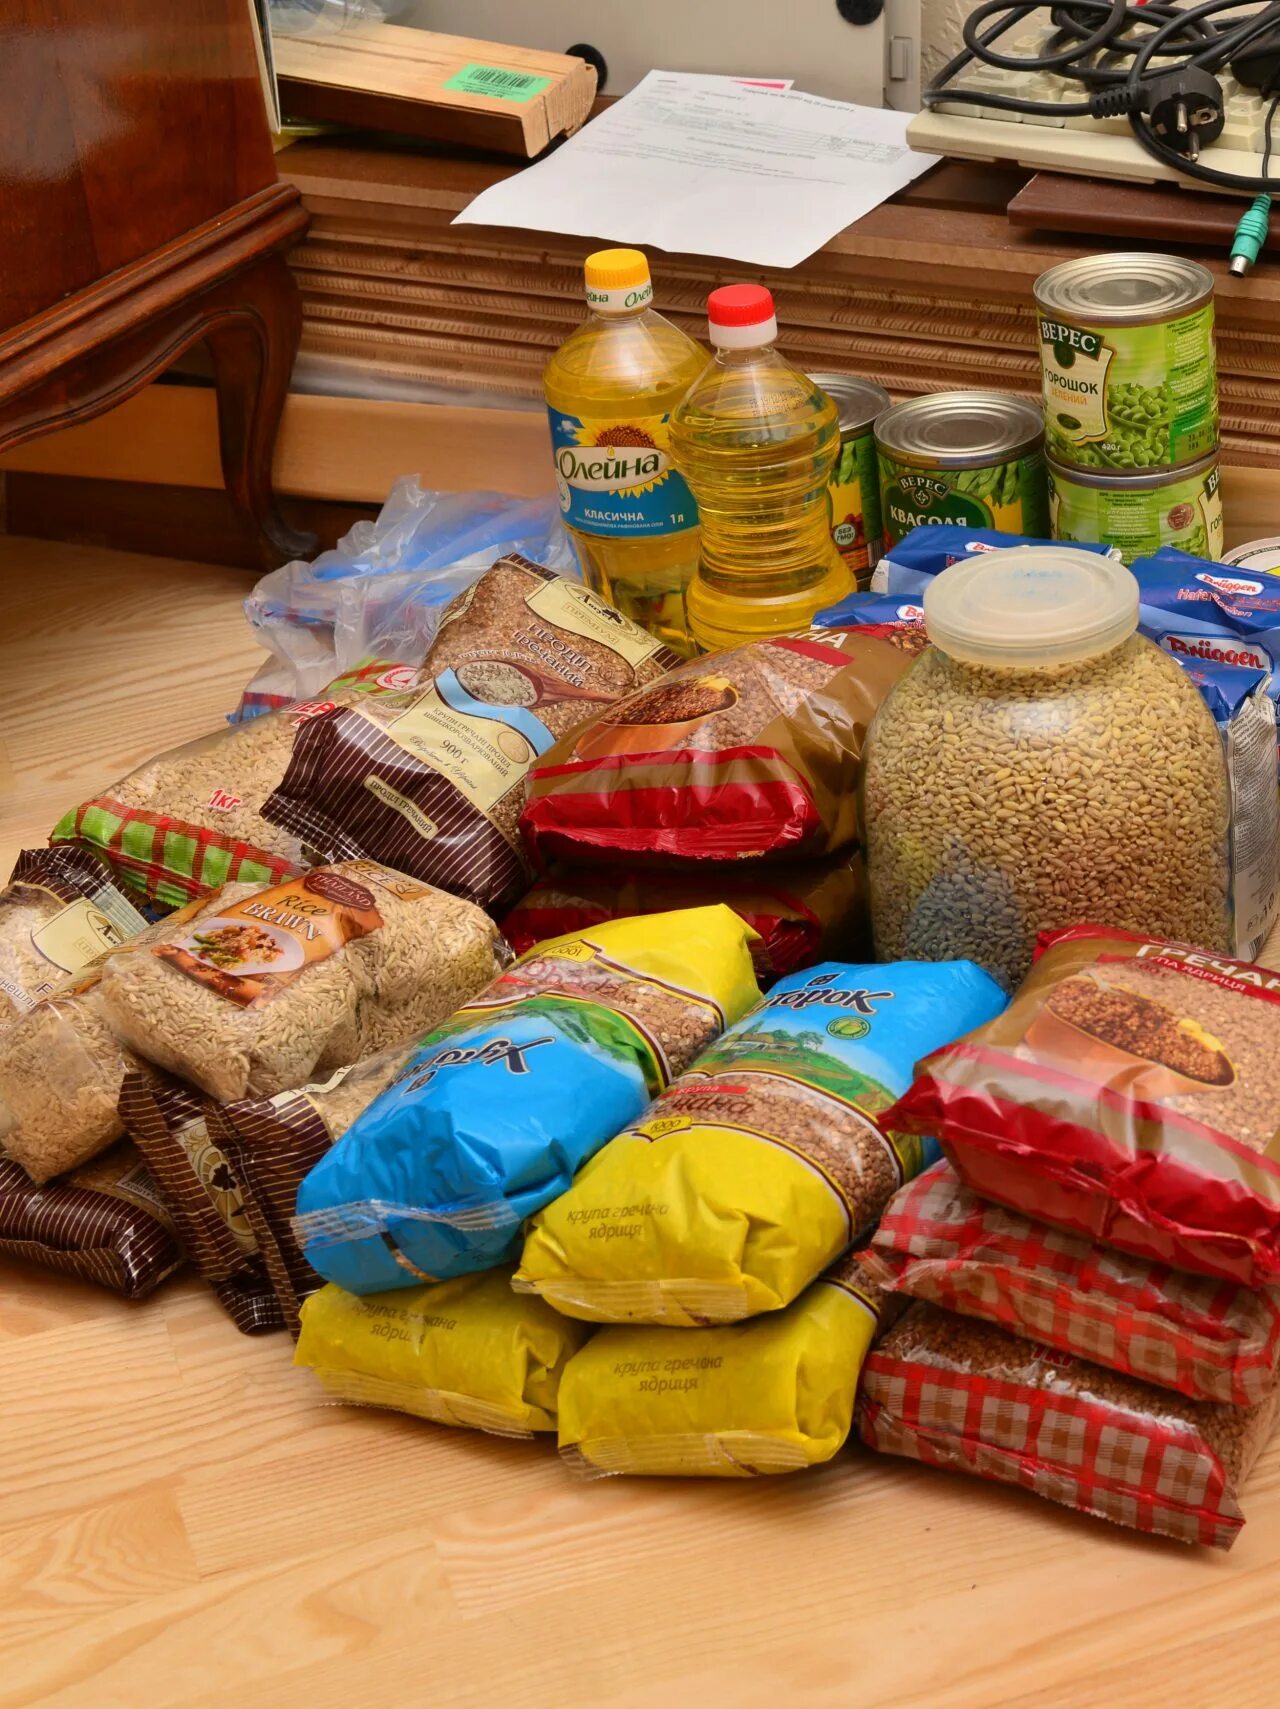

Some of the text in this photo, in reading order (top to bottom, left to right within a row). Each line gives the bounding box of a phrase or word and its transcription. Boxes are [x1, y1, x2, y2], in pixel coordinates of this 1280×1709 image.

[1041, 321, 1096, 352] ВЕРЕС
[1045, 368, 1098, 395] ГОРОШОК
[560, 450, 660, 480] Олейна
[900, 475, 946, 496] ВЕРЕС
[584, 508, 645, 521] КЛАСИЧНА
[838, 525, 851, 534] БЕЗ
[1202, 575, 1257, 592] Brüggen
[440, 739, 461, 759] 900
[208, 789, 242, 813] 1кг
[370, 780, 433, 834] ПРОДІЛ ГРЕЧАНИЙ
[277, 895, 329, 916] Rice
[241, 902, 323, 941] BRAWN
[1182, 965, 1246, 991] ЯДРИЦЯ
[768, 988, 895, 1015] торок
[567, 1205, 610, 1224] крупа
[589, 1225, 643, 1240] ядриця
[614, 1360, 660, 1376] крупа
[638, 1376, 698, 1393] ядриця
